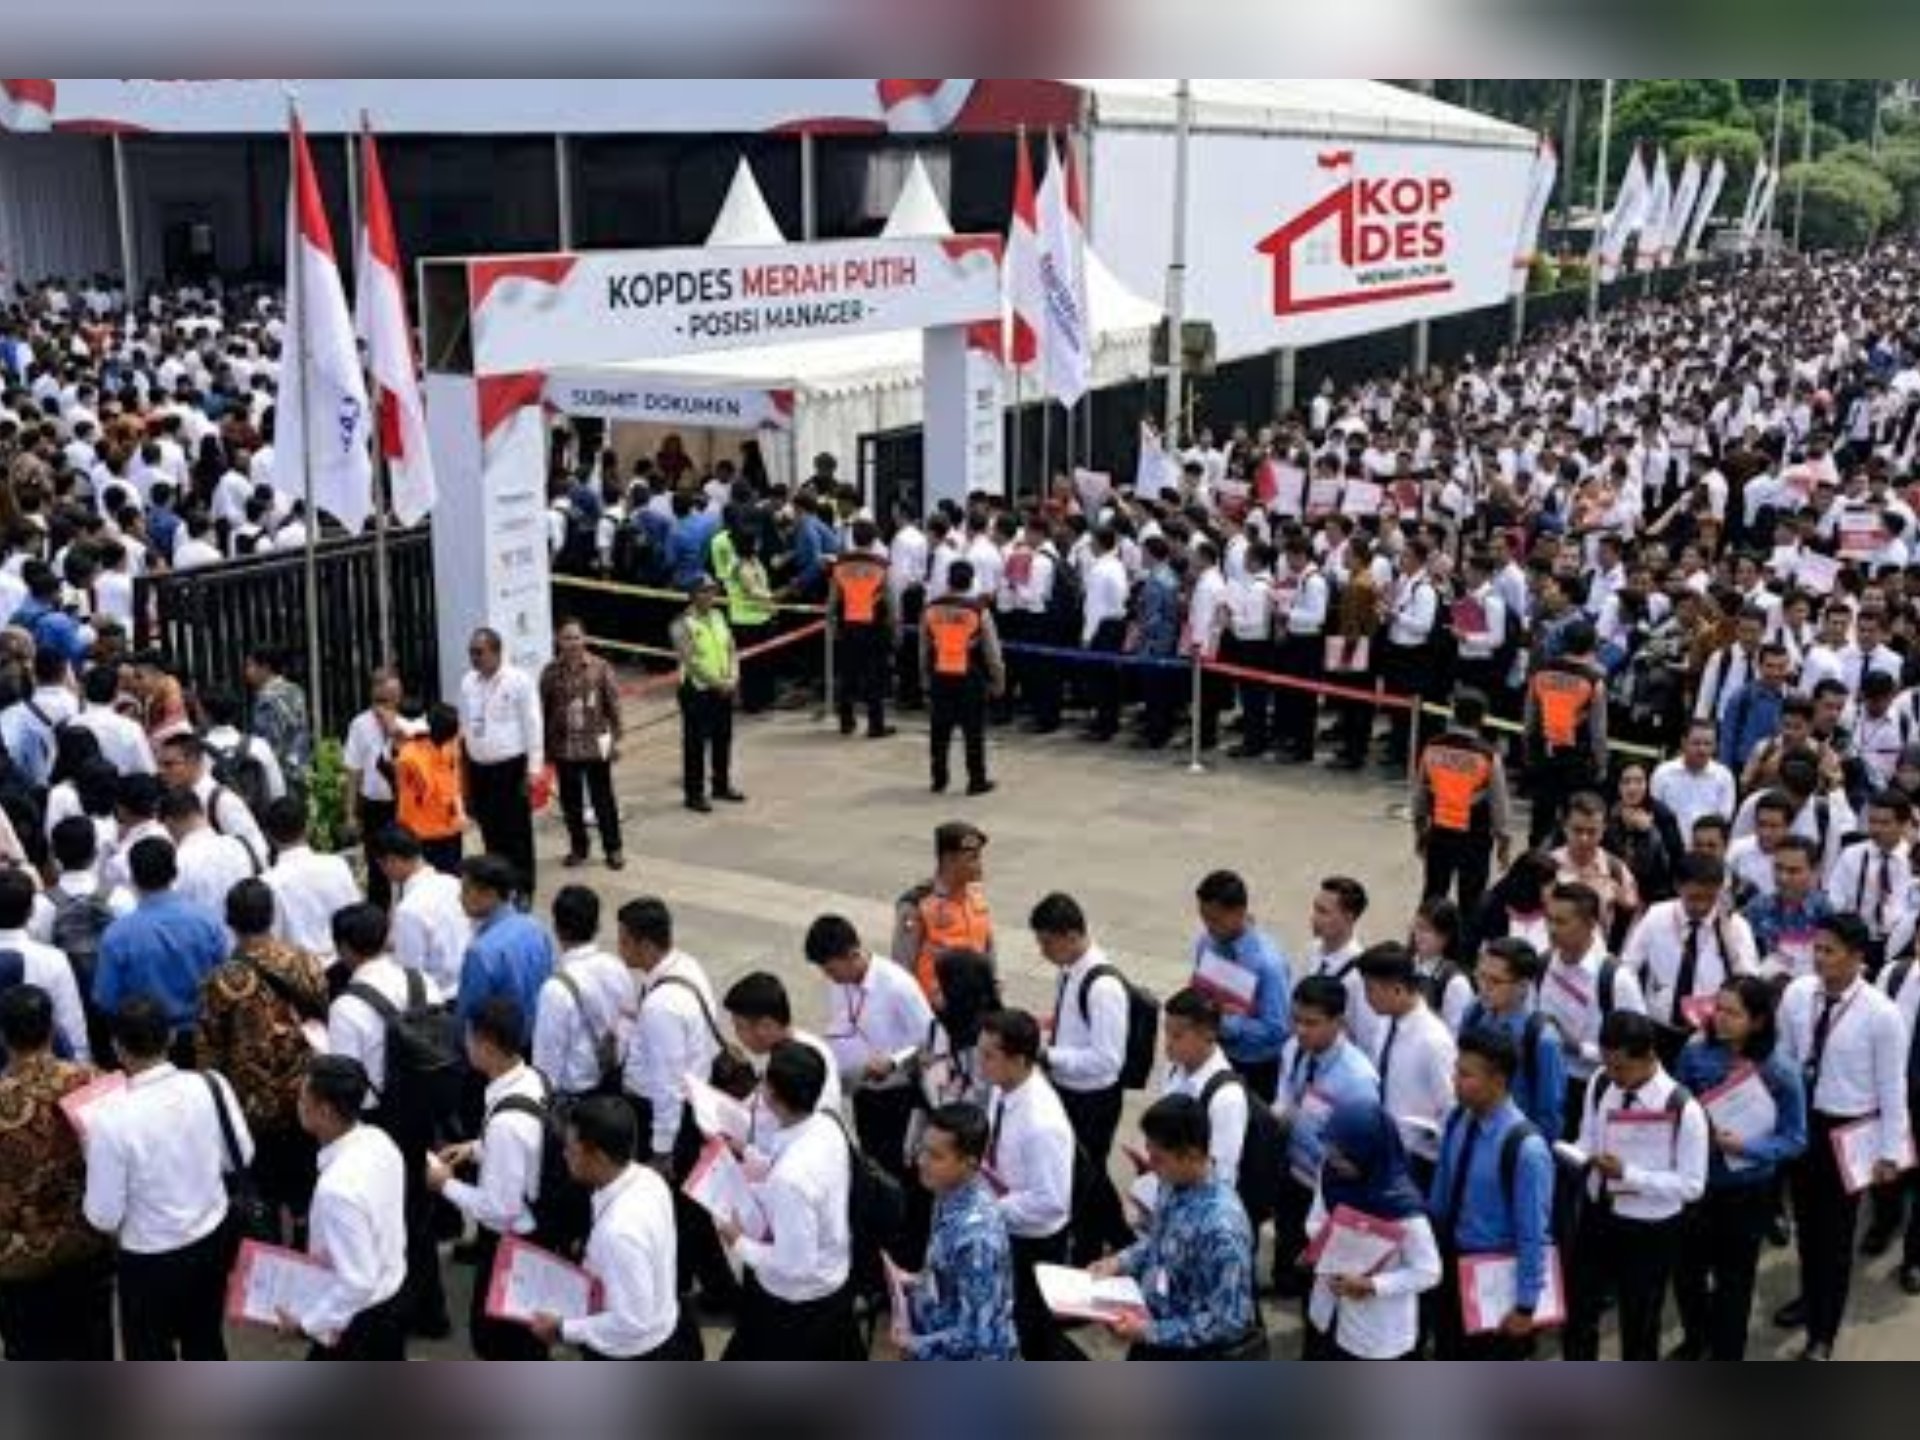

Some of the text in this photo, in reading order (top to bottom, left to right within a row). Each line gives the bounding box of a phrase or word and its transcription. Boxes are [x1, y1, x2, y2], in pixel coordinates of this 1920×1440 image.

[1359, 178, 1451, 215] KOP
[1359, 222, 1444, 263] DES
[608, 257, 916, 309] KOPDES MERAH PUTIH
[690, 311, 759, 339] POSISI
[765, 299, 863, 330] MANAGER
[645, 393, 740, 417] DOKUMEN
